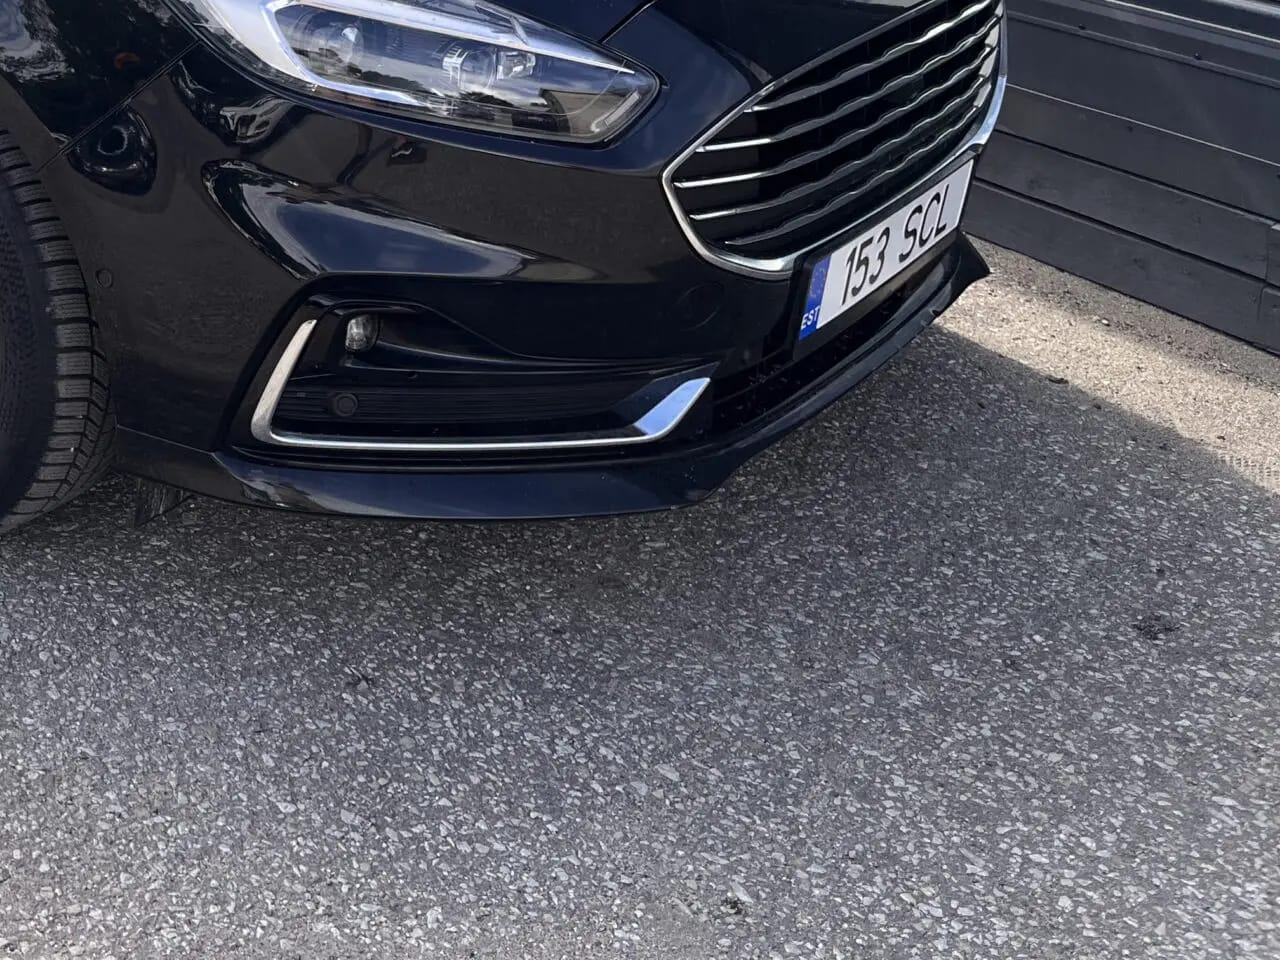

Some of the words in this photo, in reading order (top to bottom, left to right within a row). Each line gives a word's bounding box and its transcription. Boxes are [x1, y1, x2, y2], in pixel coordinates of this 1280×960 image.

[841, 227, 890, 306] 153
[898, 183, 950, 263] SCL
[800, 305, 820, 330] EST
